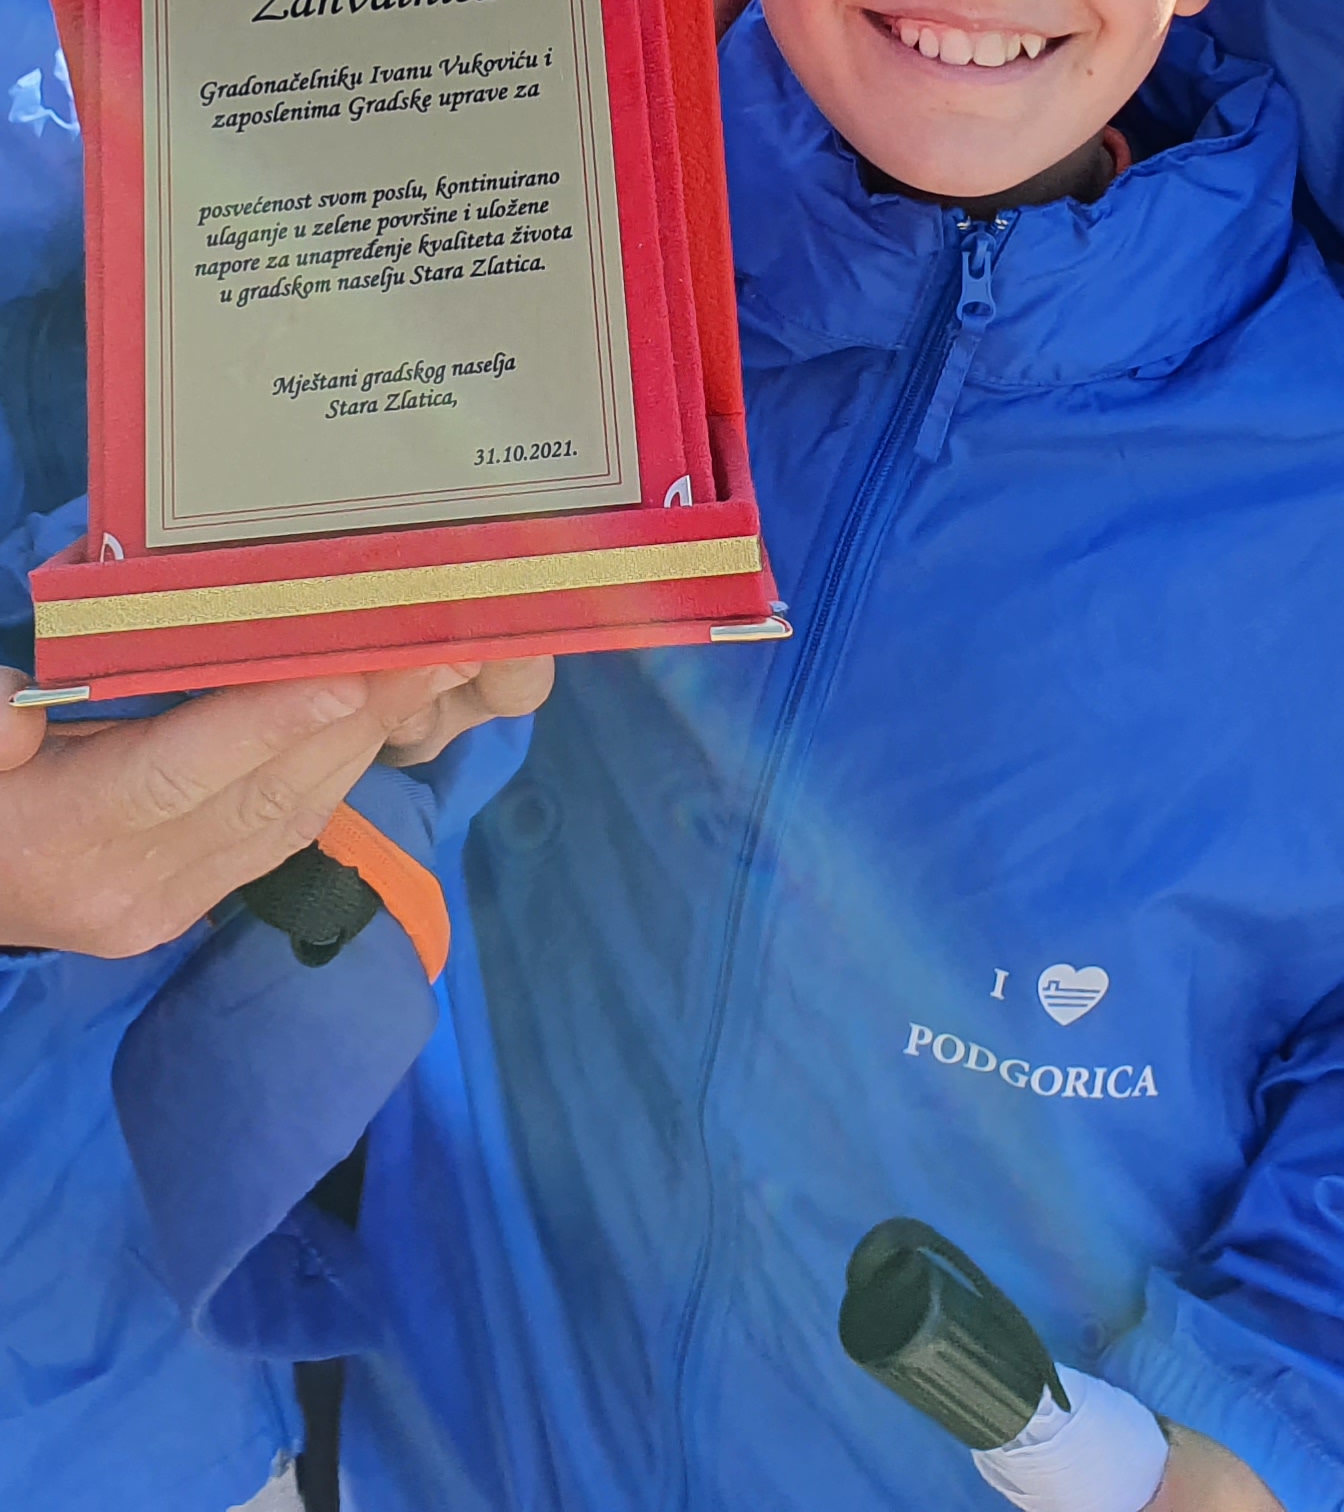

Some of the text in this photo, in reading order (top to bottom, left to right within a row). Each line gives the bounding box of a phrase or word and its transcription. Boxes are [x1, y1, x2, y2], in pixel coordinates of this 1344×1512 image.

[200, 47, 553, 106] Gradonačelniku Ivanu Vukoviću i
[211, 80, 540, 133] zaposlenima Gradske uprave za
[197, 170, 560, 226] posvećenost svom poslu, kontinuirano
[206, 197, 550, 251] ulaganje u zelene površine i uložene
[194, 222, 574, 281] napore za unapređenje kvaliteta života
[219, 254, 546, 308] u gradskom naselju Stara Zlatica.
[272, 351, 516, 399] Mještani gradskog naselja
[325, 389, 458, 419] Stara Zlatica,
[473, 439, 579, 466] 31.10.2021.
[989, 967, 1009, 1000] I
[902, 1022, 1159, 1099] PODGORICA
